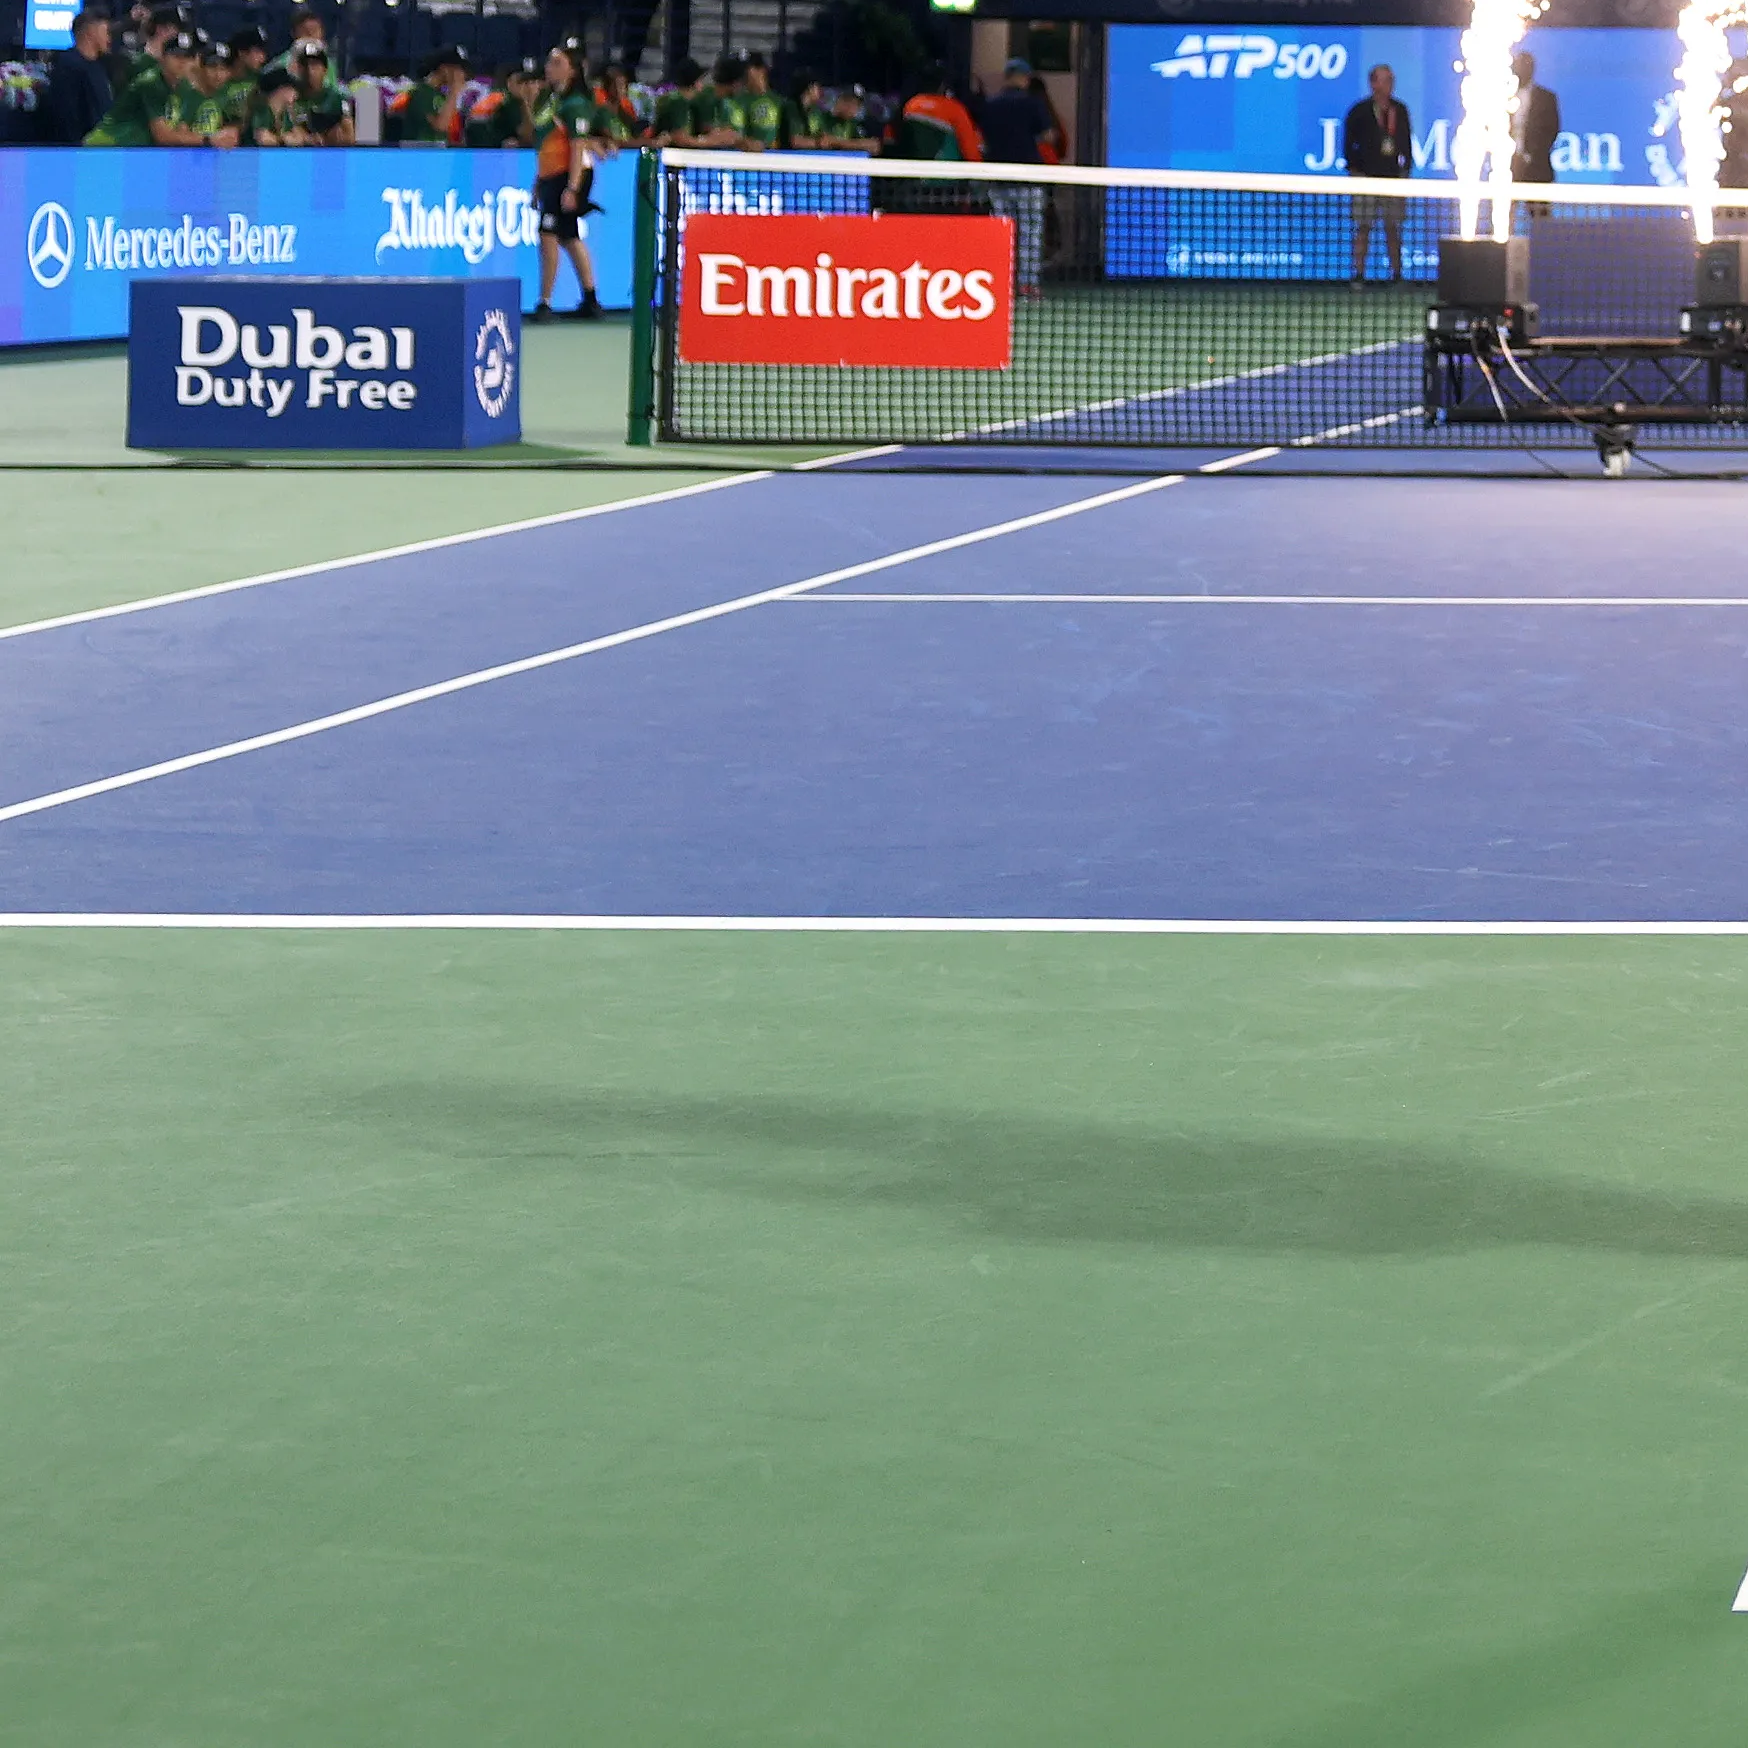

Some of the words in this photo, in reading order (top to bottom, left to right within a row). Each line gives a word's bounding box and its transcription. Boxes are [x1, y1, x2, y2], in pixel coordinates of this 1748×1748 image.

[84, 212, 298, 271] Mercedes-Benz
[698, 252, 996, 321] Emirates
[177, 306, 415, 371] Dubai
[175, 366, 295, 418] Duty
[305, 369, 417, 409] Free
